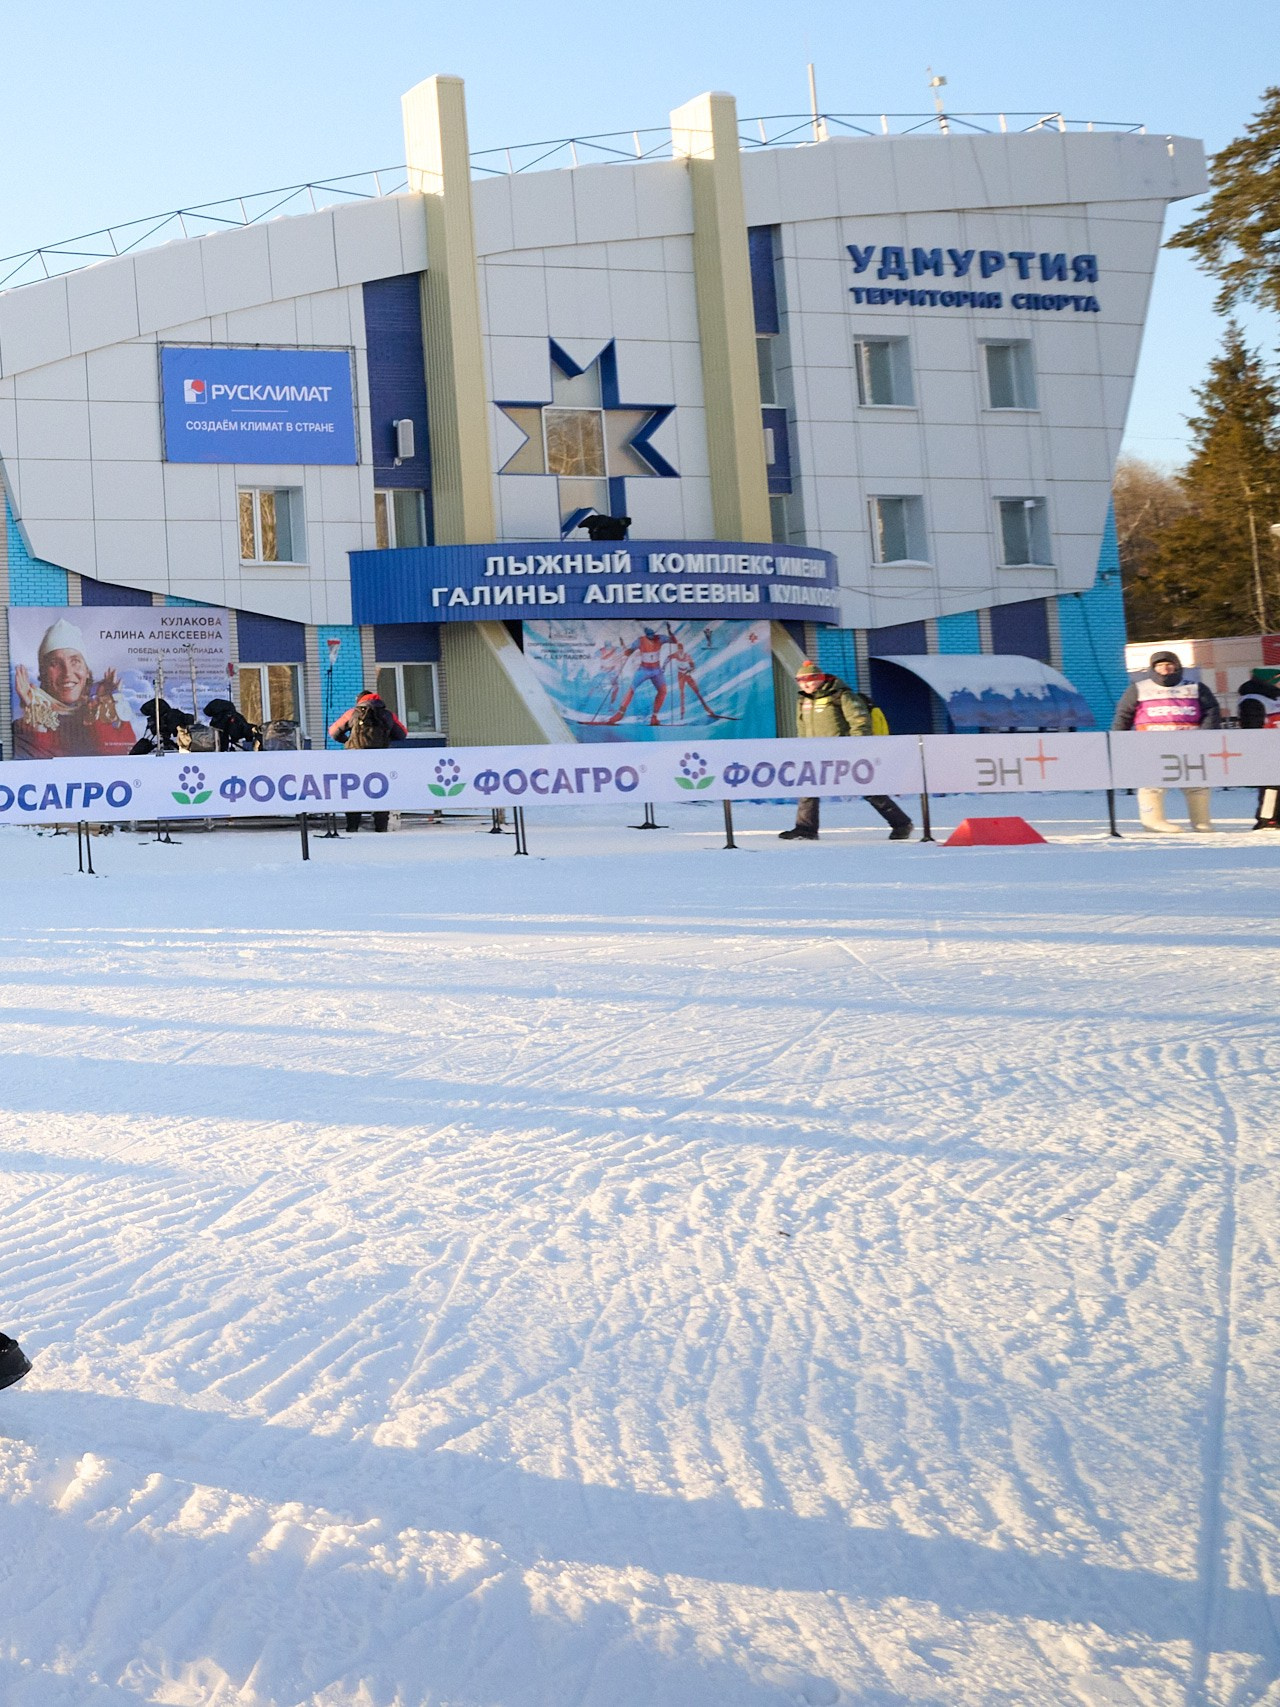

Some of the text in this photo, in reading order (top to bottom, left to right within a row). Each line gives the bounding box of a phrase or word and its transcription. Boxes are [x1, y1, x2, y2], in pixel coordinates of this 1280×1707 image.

[846, 244, 1100, 283] УДМУРТИЯ
[849, 286, 1101, 313] ТЕРРИТОРИЯ СПОРТА
[211, 384, 333, 403] РУСКЛИМАТ
[186, 418, 335, 433] СОЗДАЁМ КЛИМАТ В СТРАНЕ
[484, 550, 827, 579] ЛЫЖНЫЙ КОМПЛЕКС ИМЕНИ
[431, 584, 566, 607] ГАЛИНЫ
[583, 582, 760, 605] АЛЕКСЕЕВНЫ
[161, 617, 222, 627] КУЛАКОВА
[100, 630, 223, 640] ГАЛИНА АЛЕКСЕЕВНА
[172, 647, 224, 655] ОЛИПИАДАХ
